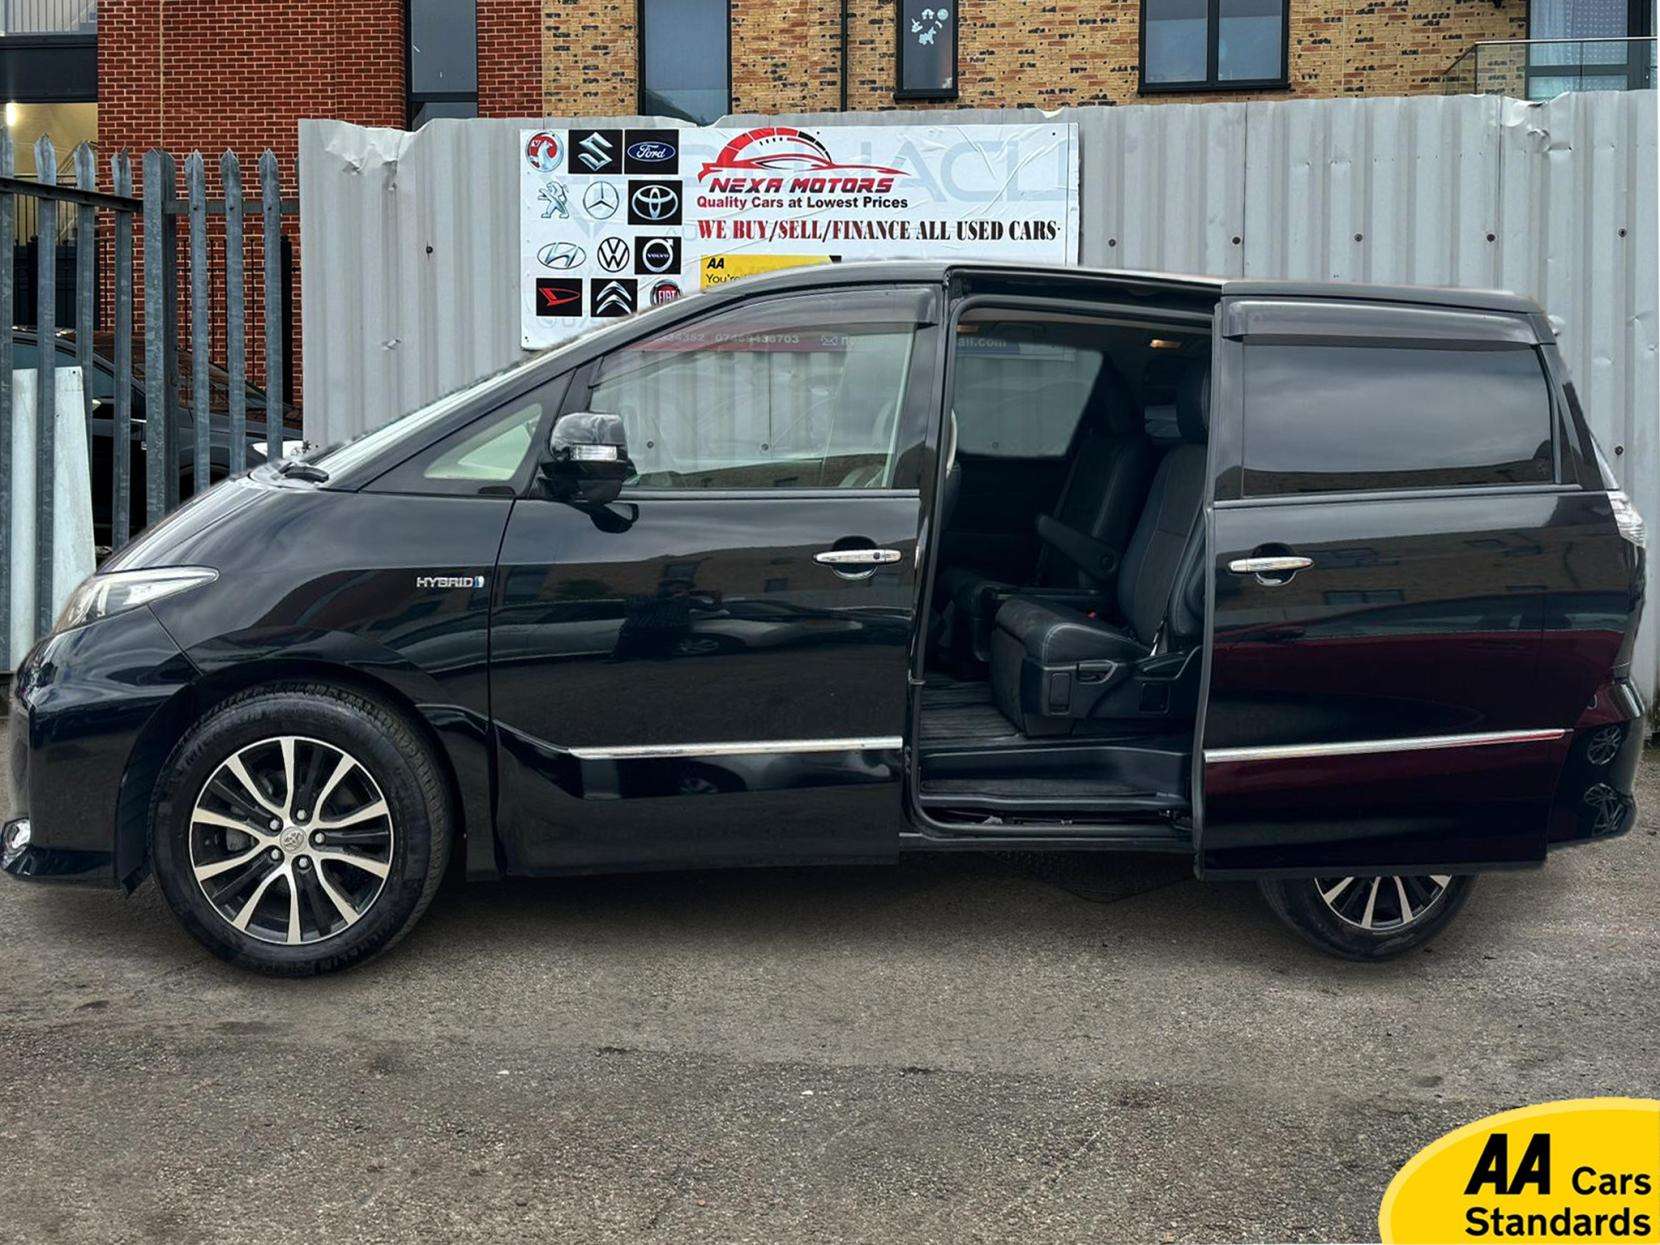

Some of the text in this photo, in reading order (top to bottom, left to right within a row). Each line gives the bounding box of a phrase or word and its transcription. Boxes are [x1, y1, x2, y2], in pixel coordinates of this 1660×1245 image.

[636, 144, 667, 159] Ford
[709, 177, 895, 193] NEXA MOTORS
[697, 196, 908, 210] Quality Cars at Lowest Prices
[697, 220, 727, 240] WE
[733, 219, 911, 242] BUY/SELL/FINANCE
[916, 220, 950, 240] ALL
[957, 220, 1004, 240] USED
[1008, 220, 1057, 240] CARS
[707, 258, 725, 269] AA
[658, 290, 677, 304] FIAT
[416, 576, 474, 588] HYBRID
